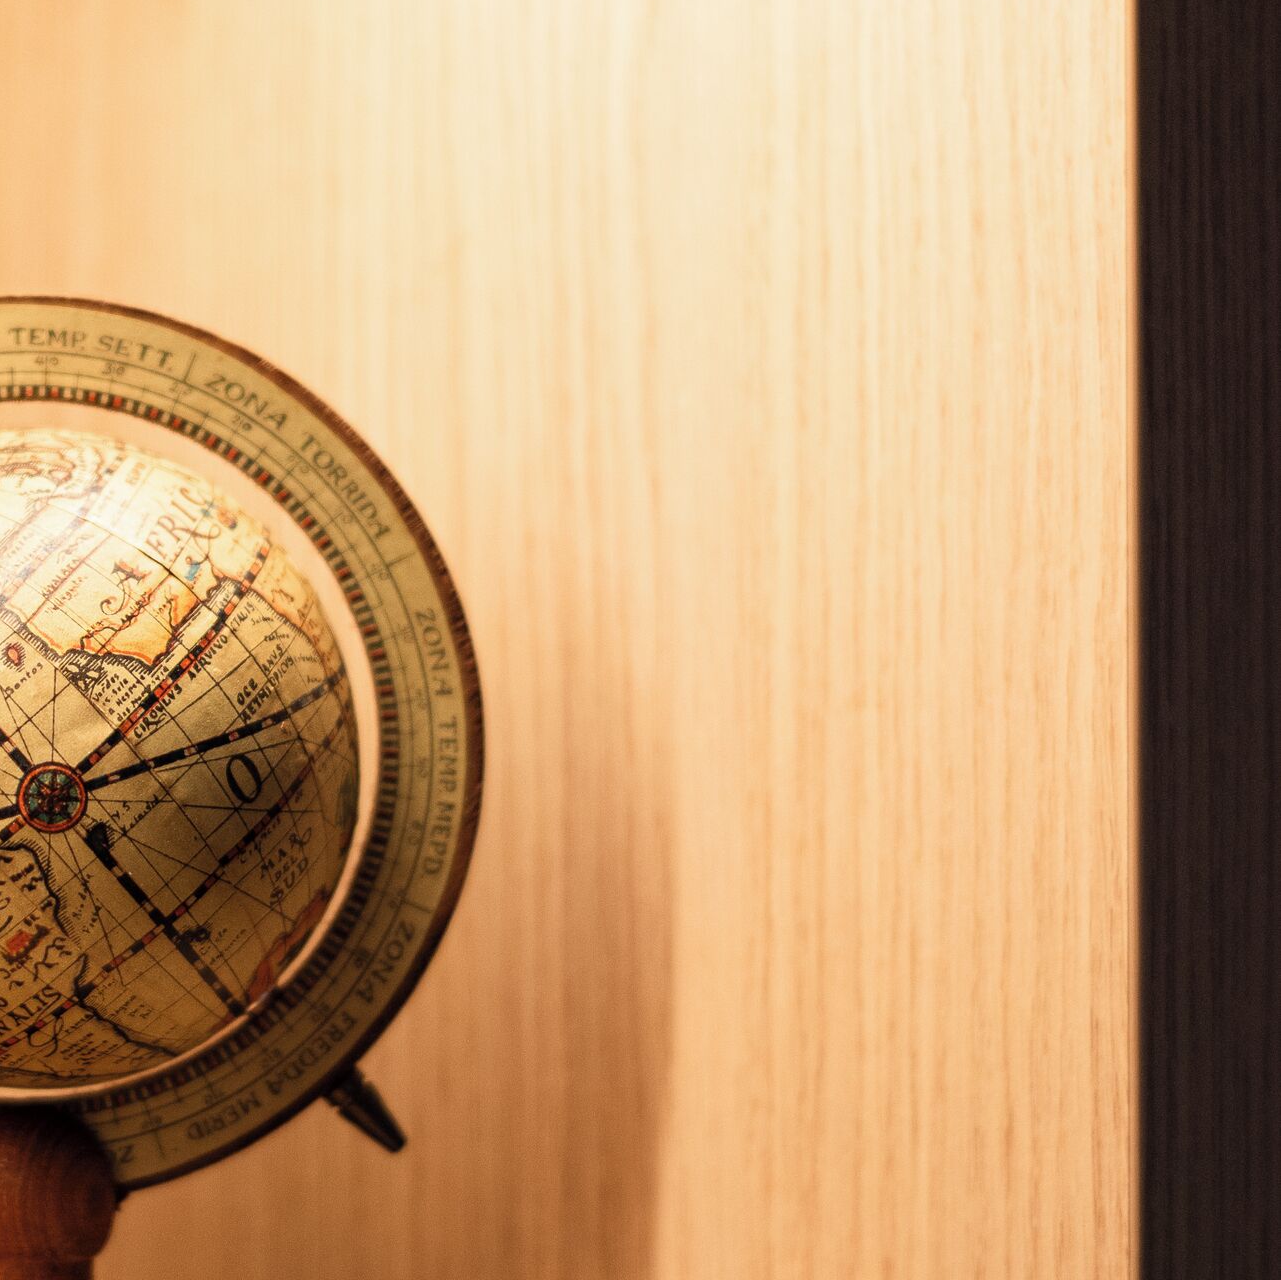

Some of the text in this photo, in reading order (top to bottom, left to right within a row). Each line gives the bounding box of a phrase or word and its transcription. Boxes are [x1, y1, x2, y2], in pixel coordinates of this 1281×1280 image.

[7, 325, 85, 350] TEMP.
[93, 330, 179, 372] SETT.
[202, 368, 393, 541] ZONA TORRIDA
[412, 605, 455, 697] ZONA
[225, 753, 263, 805] O
[352, 918, 422, 1008] ZONA
